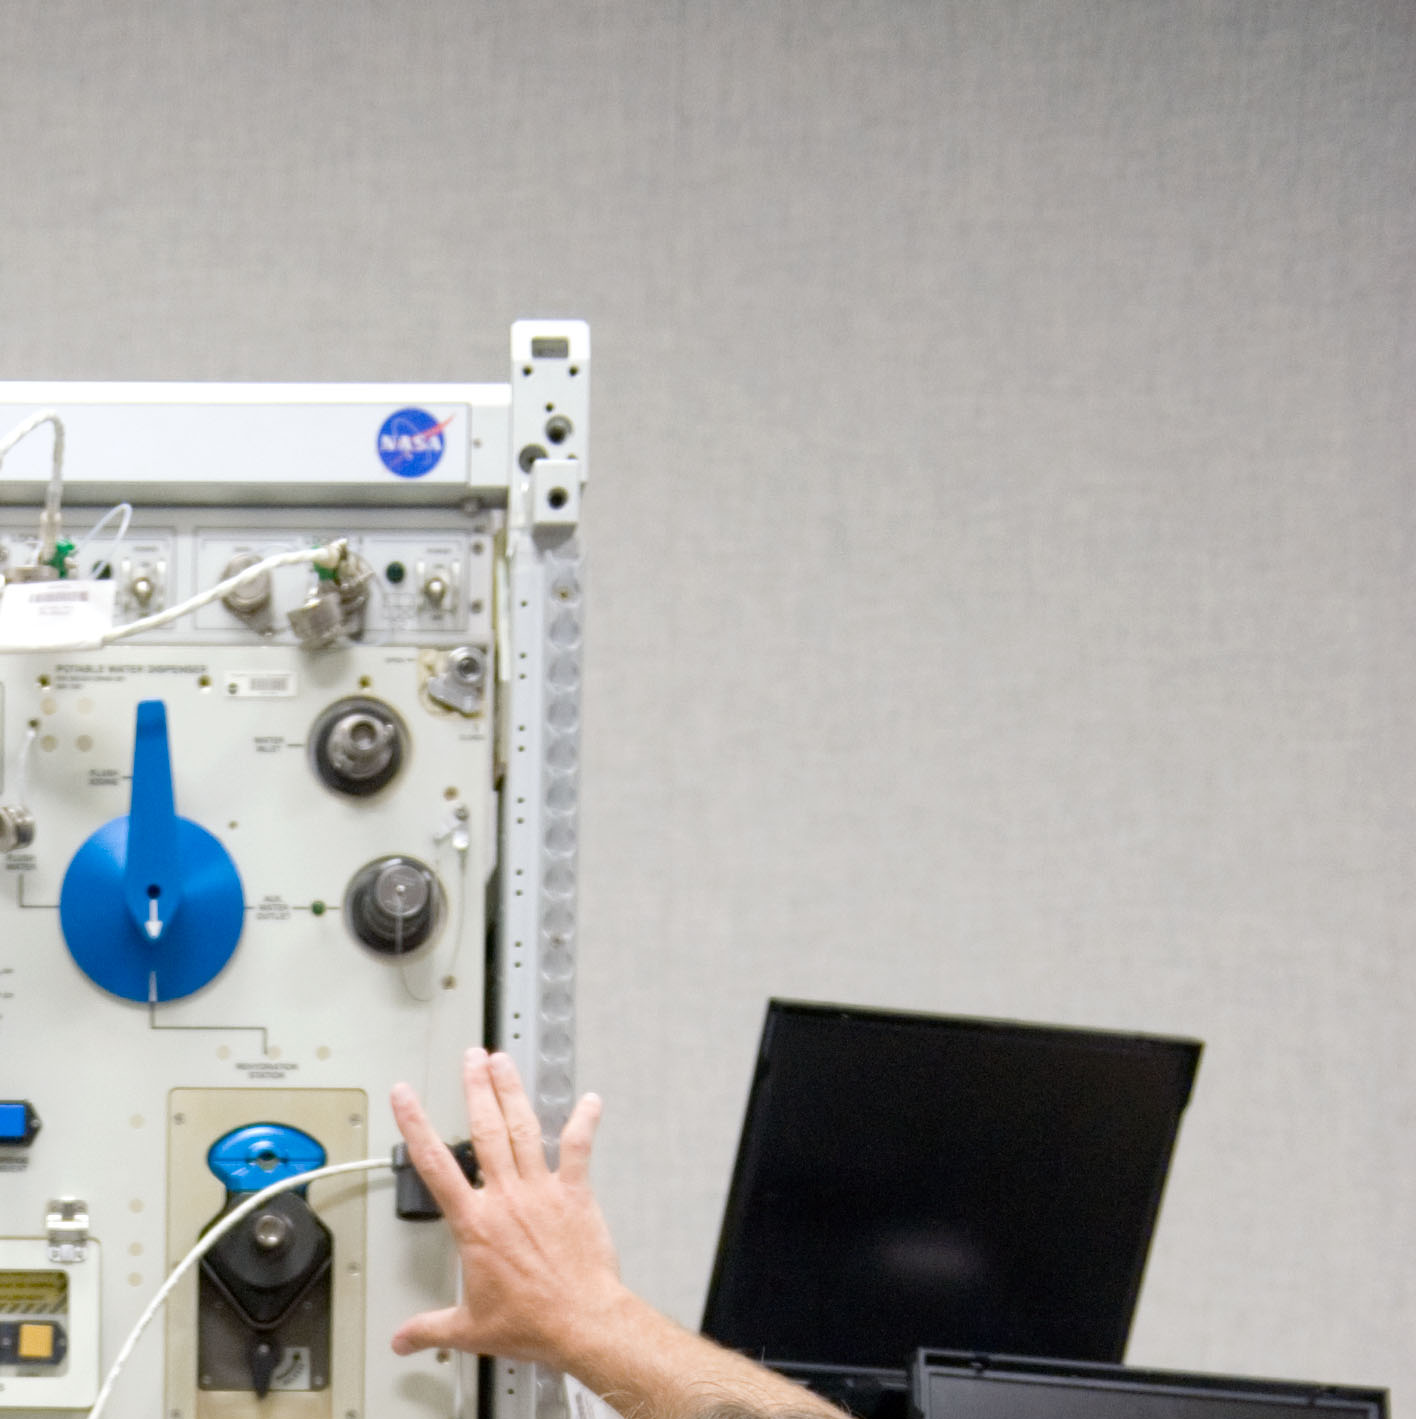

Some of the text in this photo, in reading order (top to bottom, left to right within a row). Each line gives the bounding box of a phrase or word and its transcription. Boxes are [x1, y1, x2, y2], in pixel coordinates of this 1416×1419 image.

[380, 433, 444, 451] NASA
[55, 664, 209, 675] POTABLE WATER DISPENSER
